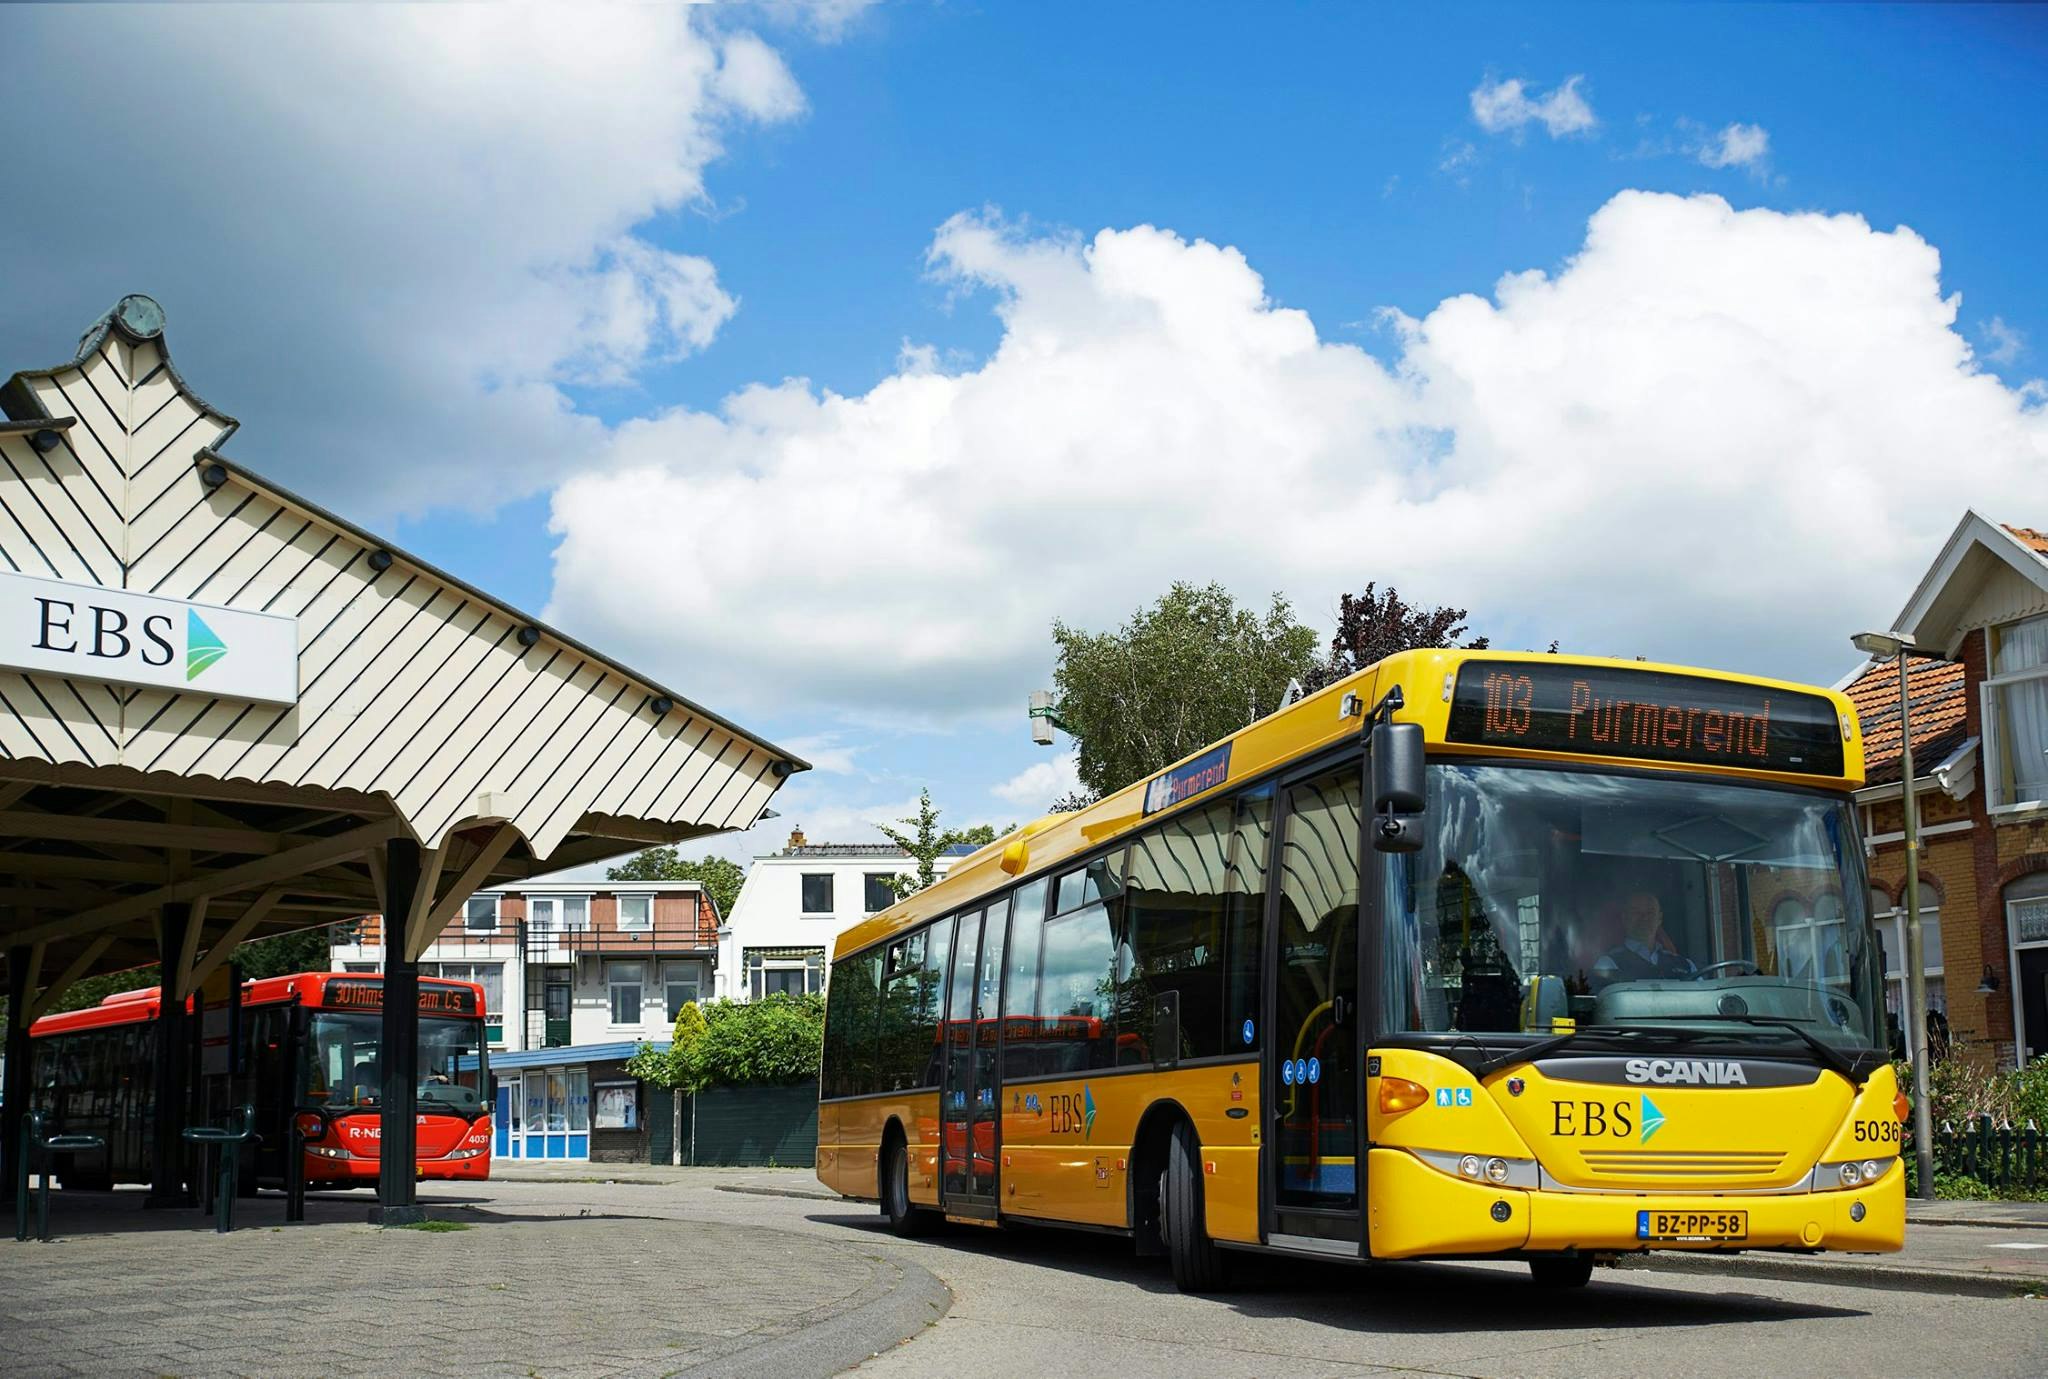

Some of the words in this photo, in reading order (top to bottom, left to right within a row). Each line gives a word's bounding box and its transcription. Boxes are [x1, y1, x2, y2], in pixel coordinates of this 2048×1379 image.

[31, 597, 174, 666] EBS
[1483, 672, 1533, 735] 103
[1569, 680, 1771, 757] Purmerend
[1625, 1059, 1748, 1085] SCANIA
[1050, 1093, 1083, 1134] EBS
[1550, 1100, 1633, 1137] EBS
[469, 1135, 489, 1144] 4031
[1854, 1120, 1899, 1143] 5036
[1657, 1215, 1740, 1234] BZ-PP-58
